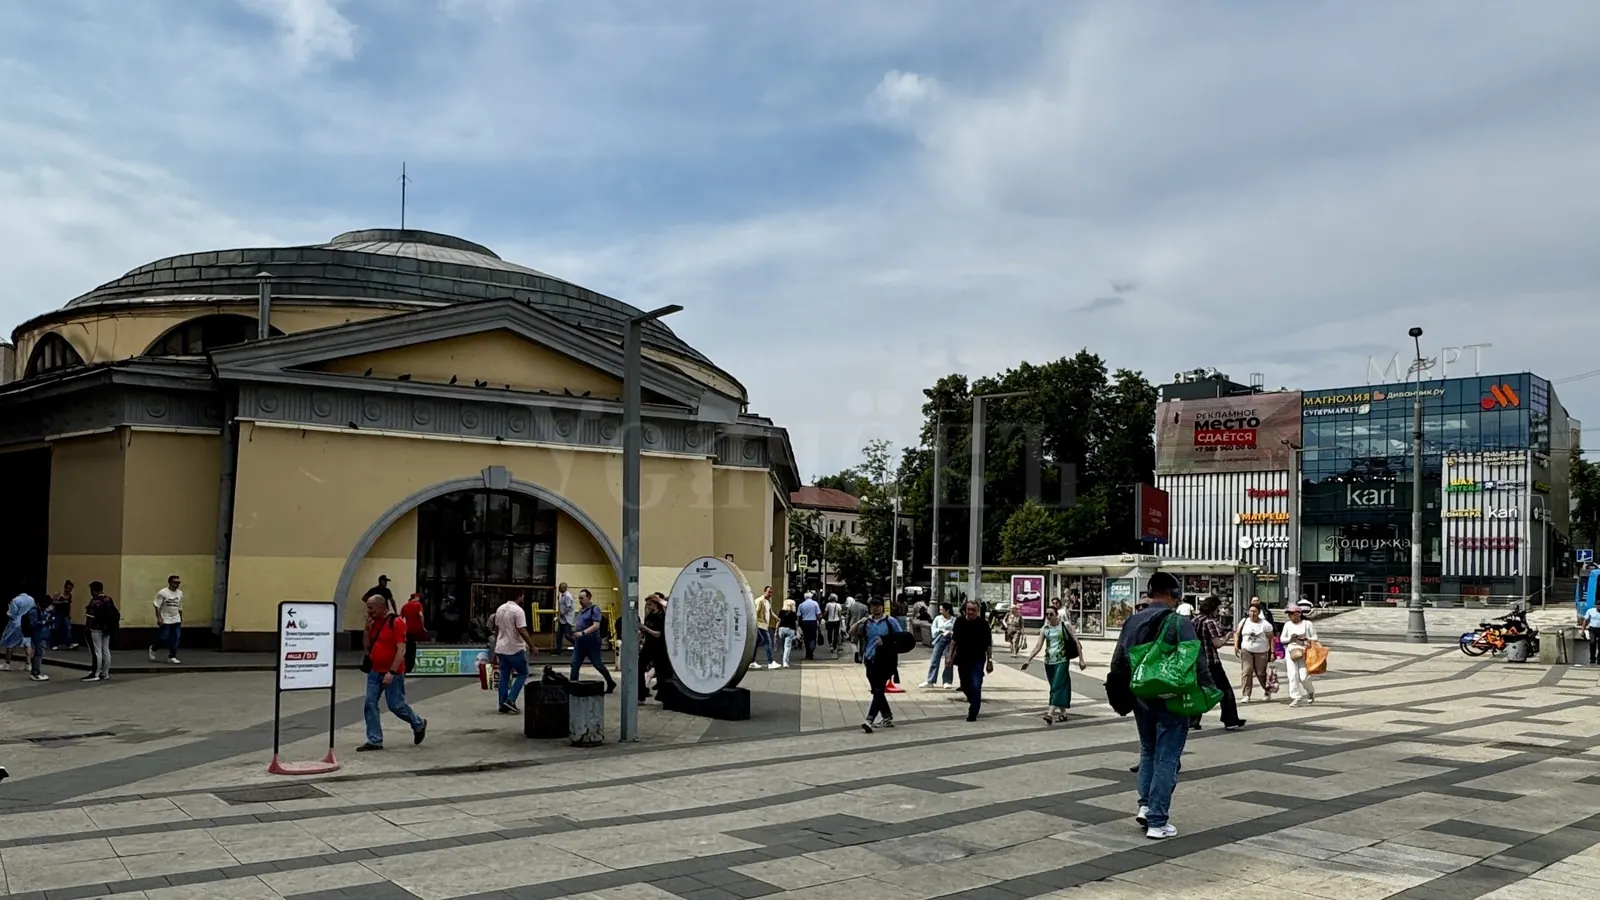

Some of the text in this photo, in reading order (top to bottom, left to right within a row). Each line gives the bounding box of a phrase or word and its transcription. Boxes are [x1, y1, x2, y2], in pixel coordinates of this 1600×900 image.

[1303, 393, 1370, 406] МАГНОЛИЯ
[1196, 409, 1258, 420] РЕКЛАМНОЕ
[1303, 406, 1358, 417] СУПЕРМАРКЕТ
[1197, 431, 1253, 443] СДАЁТСЯ
[1347, 483, 1395, 506] kari
[1488, 506, 1518, 518] kari
[1325, 534, 1412, 552] Подружка
